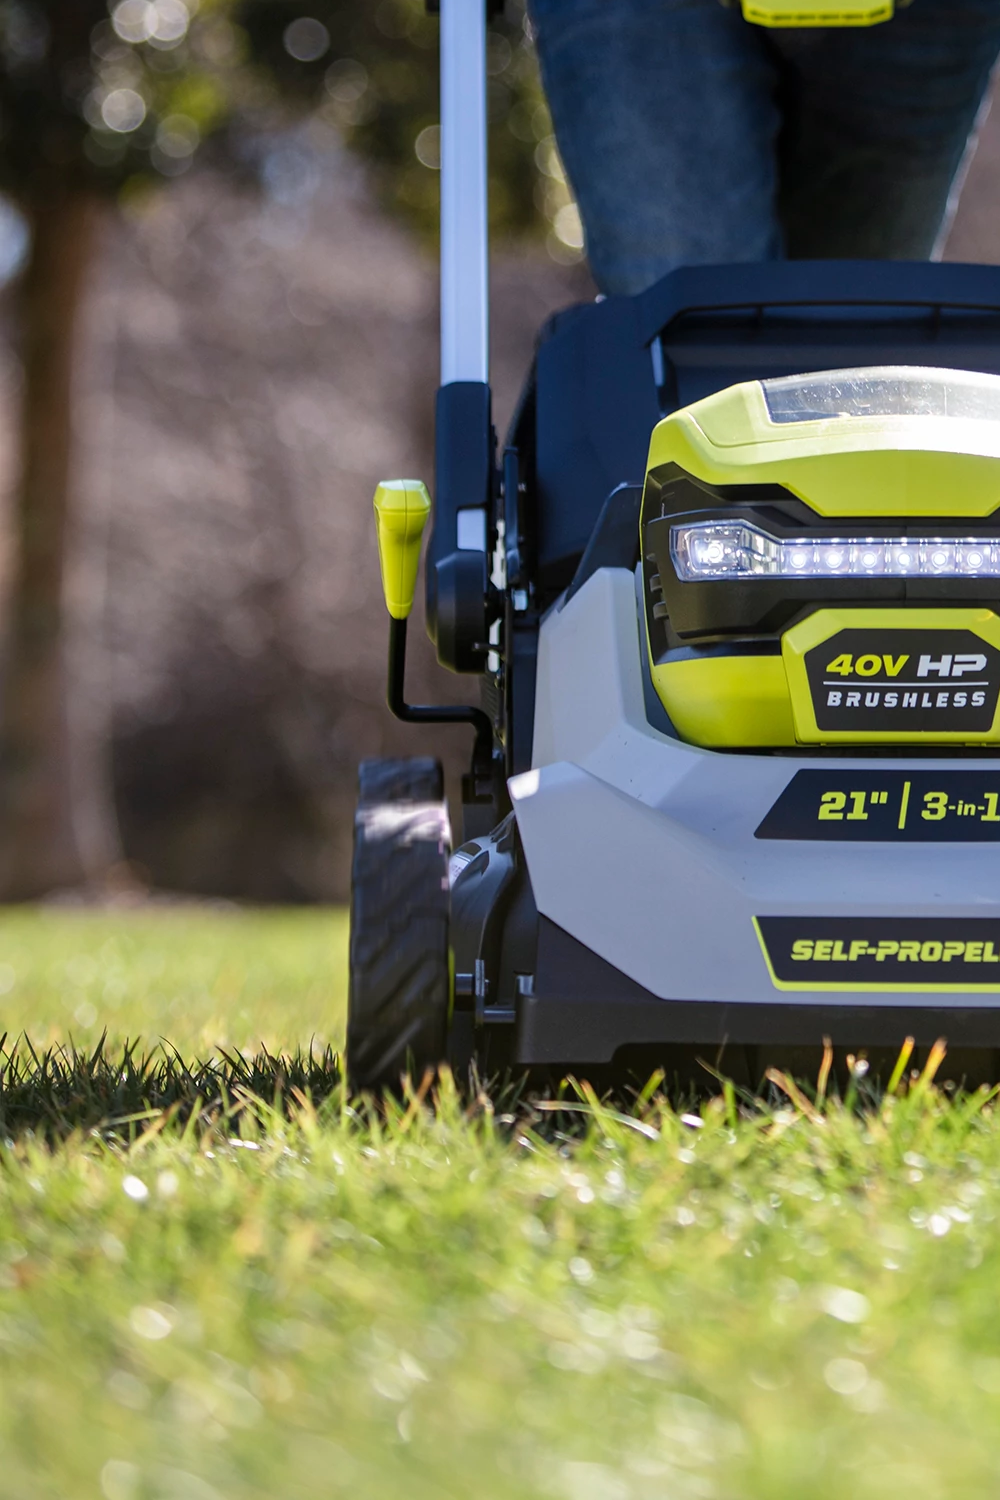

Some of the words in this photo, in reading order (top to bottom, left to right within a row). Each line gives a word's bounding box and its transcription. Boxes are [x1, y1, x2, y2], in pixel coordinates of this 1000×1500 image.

[826, 654, 909, 677] 40V
[917, 654, 987, 677] HP
[827, 691, 986, 708] BRUSHLESS
[818, 791, 888, 820] 21"
